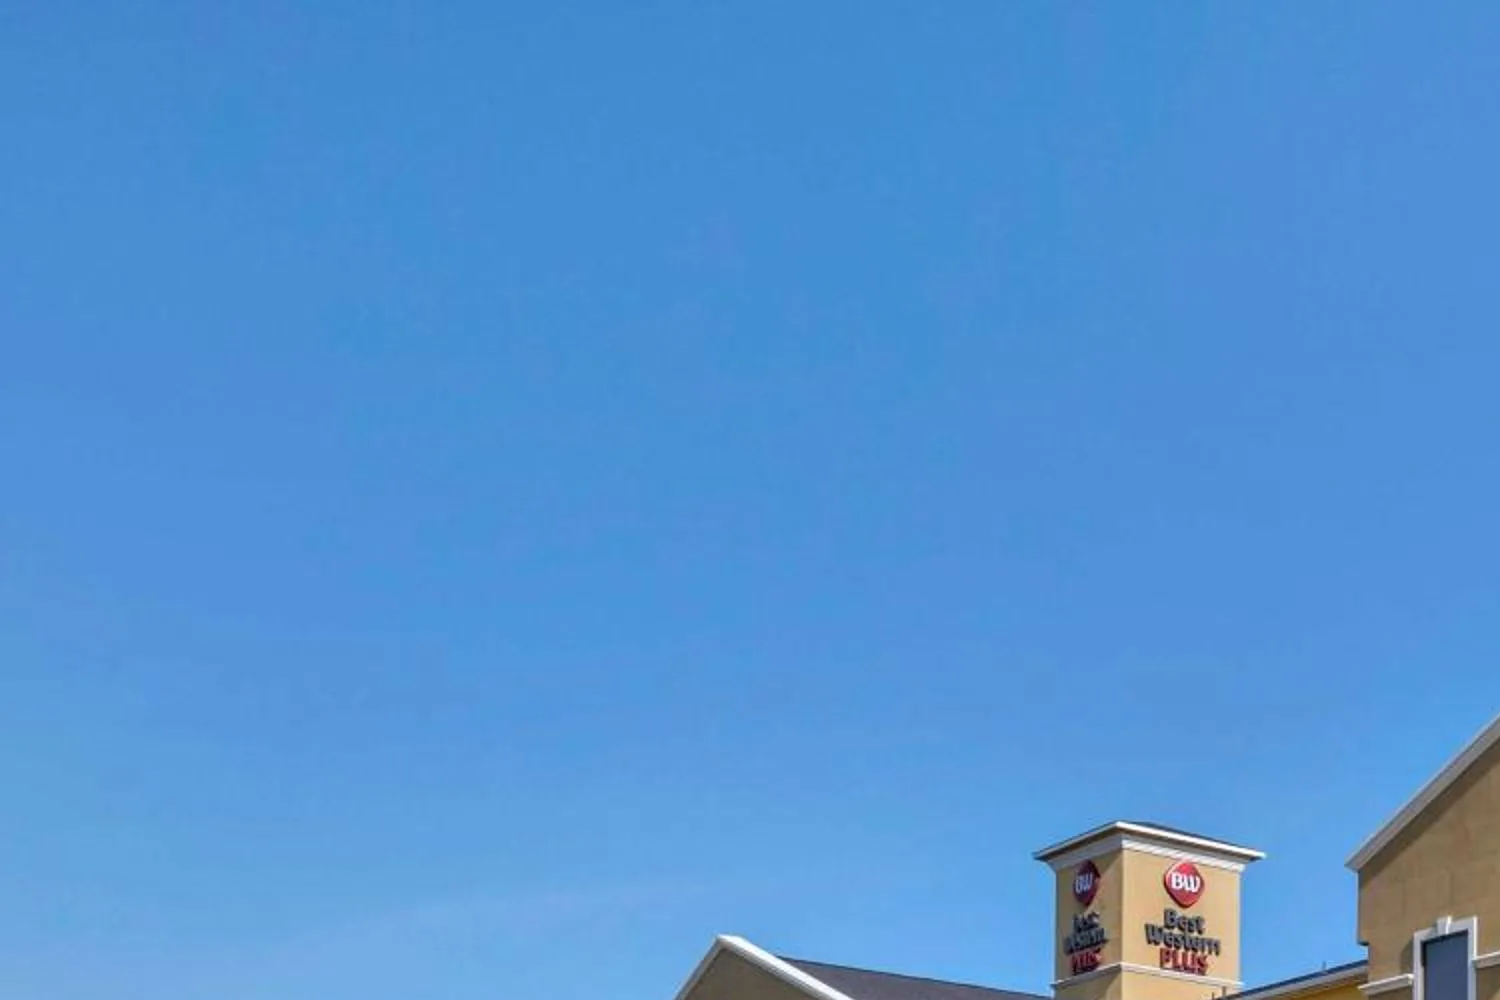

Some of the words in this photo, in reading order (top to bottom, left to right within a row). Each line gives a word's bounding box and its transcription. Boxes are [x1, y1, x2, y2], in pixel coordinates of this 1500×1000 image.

[1171, 872, 1200, 893] BW
[1163, 908, 1205, 934] Best
[1144, 923, 1221, 956] Western
[1160, 948, 1207, 976] PLUS
